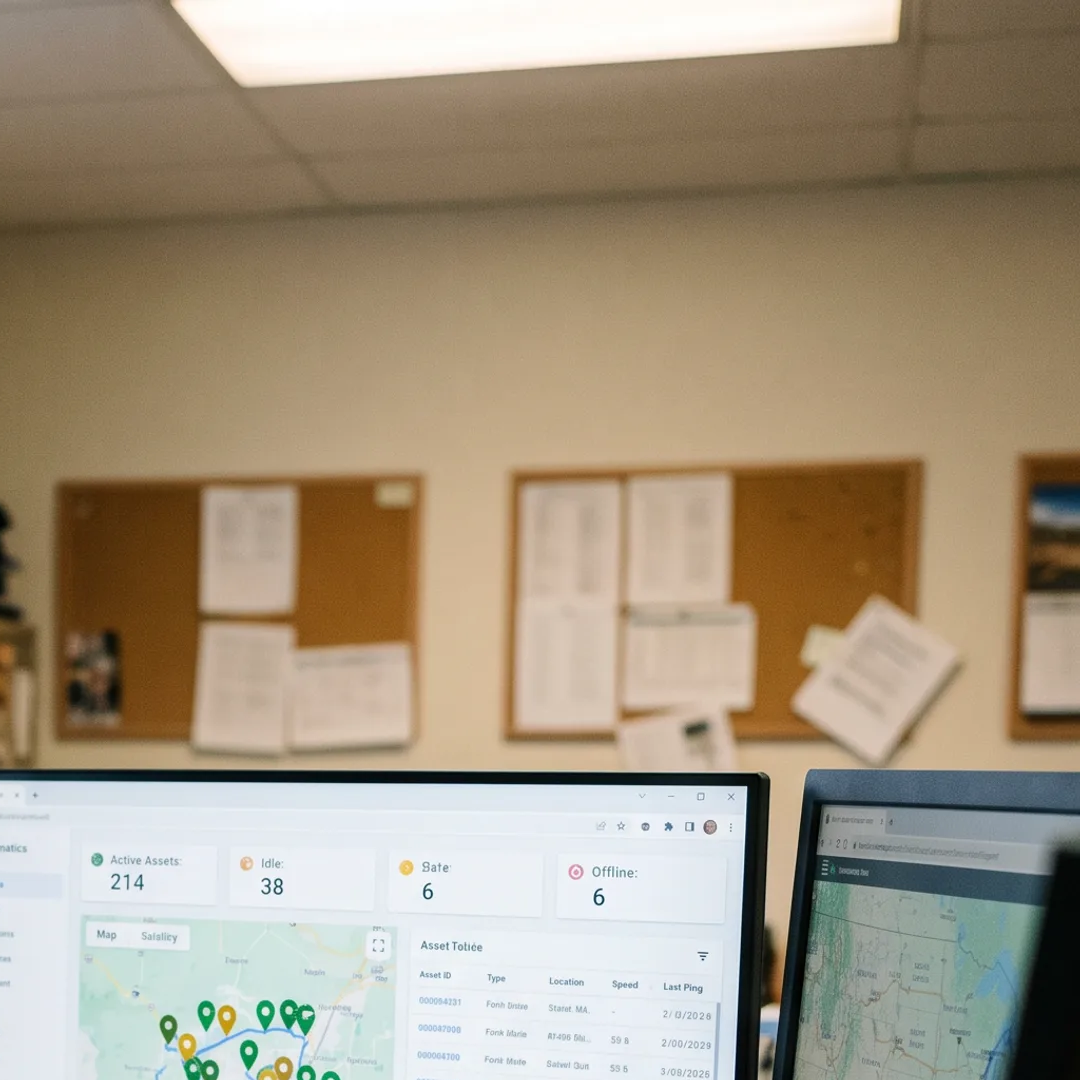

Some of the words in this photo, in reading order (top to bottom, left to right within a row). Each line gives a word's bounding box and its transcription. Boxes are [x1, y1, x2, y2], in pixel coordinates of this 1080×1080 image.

[110, 855, 142, 866] Active
[144, 856, 183, 866] Assets:
[261, 858, 284, 869] Idle:
[591, 866, 638, 878] Offline:
[110, 873, 145, 891] 214
[261, 878, 284, 895] 38
[97, 930, 117, 941] Map
[421, 940, 449, 951] Asset
[419, 971, 441, 979] Asset
[487, 974, 506, 983] Type
[549, 977, 584, 986] Location
[612, 980, 638, 990] Speed
[663, 983, 681, 991] Last
[683, 984, 703, 994] Ping
